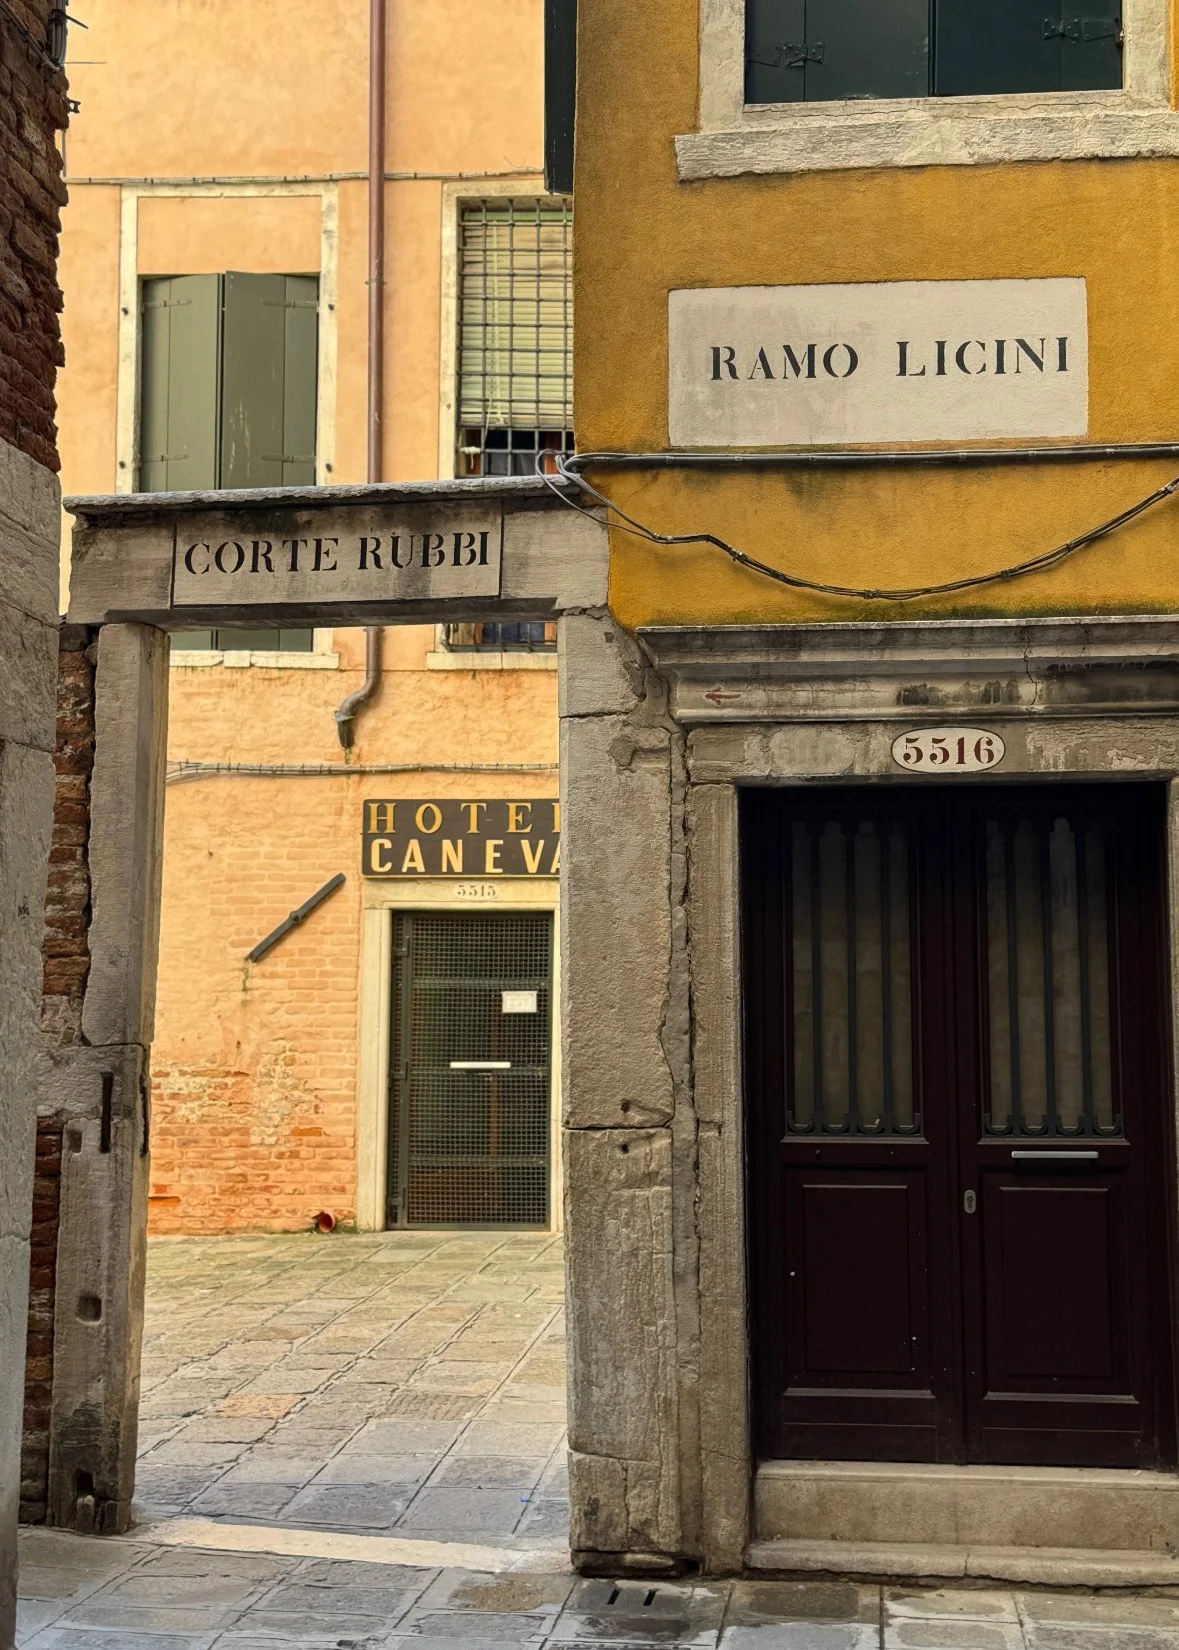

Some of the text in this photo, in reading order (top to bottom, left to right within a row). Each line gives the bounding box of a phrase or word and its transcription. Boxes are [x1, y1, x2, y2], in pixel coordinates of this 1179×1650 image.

[710, 336, 1070, 381] RAMO LICINI
[184, 531, 490, 575] CORTE RUBBI
[903, 736, 995, 765] 5516
[457, 884, 496, 897] 5515
